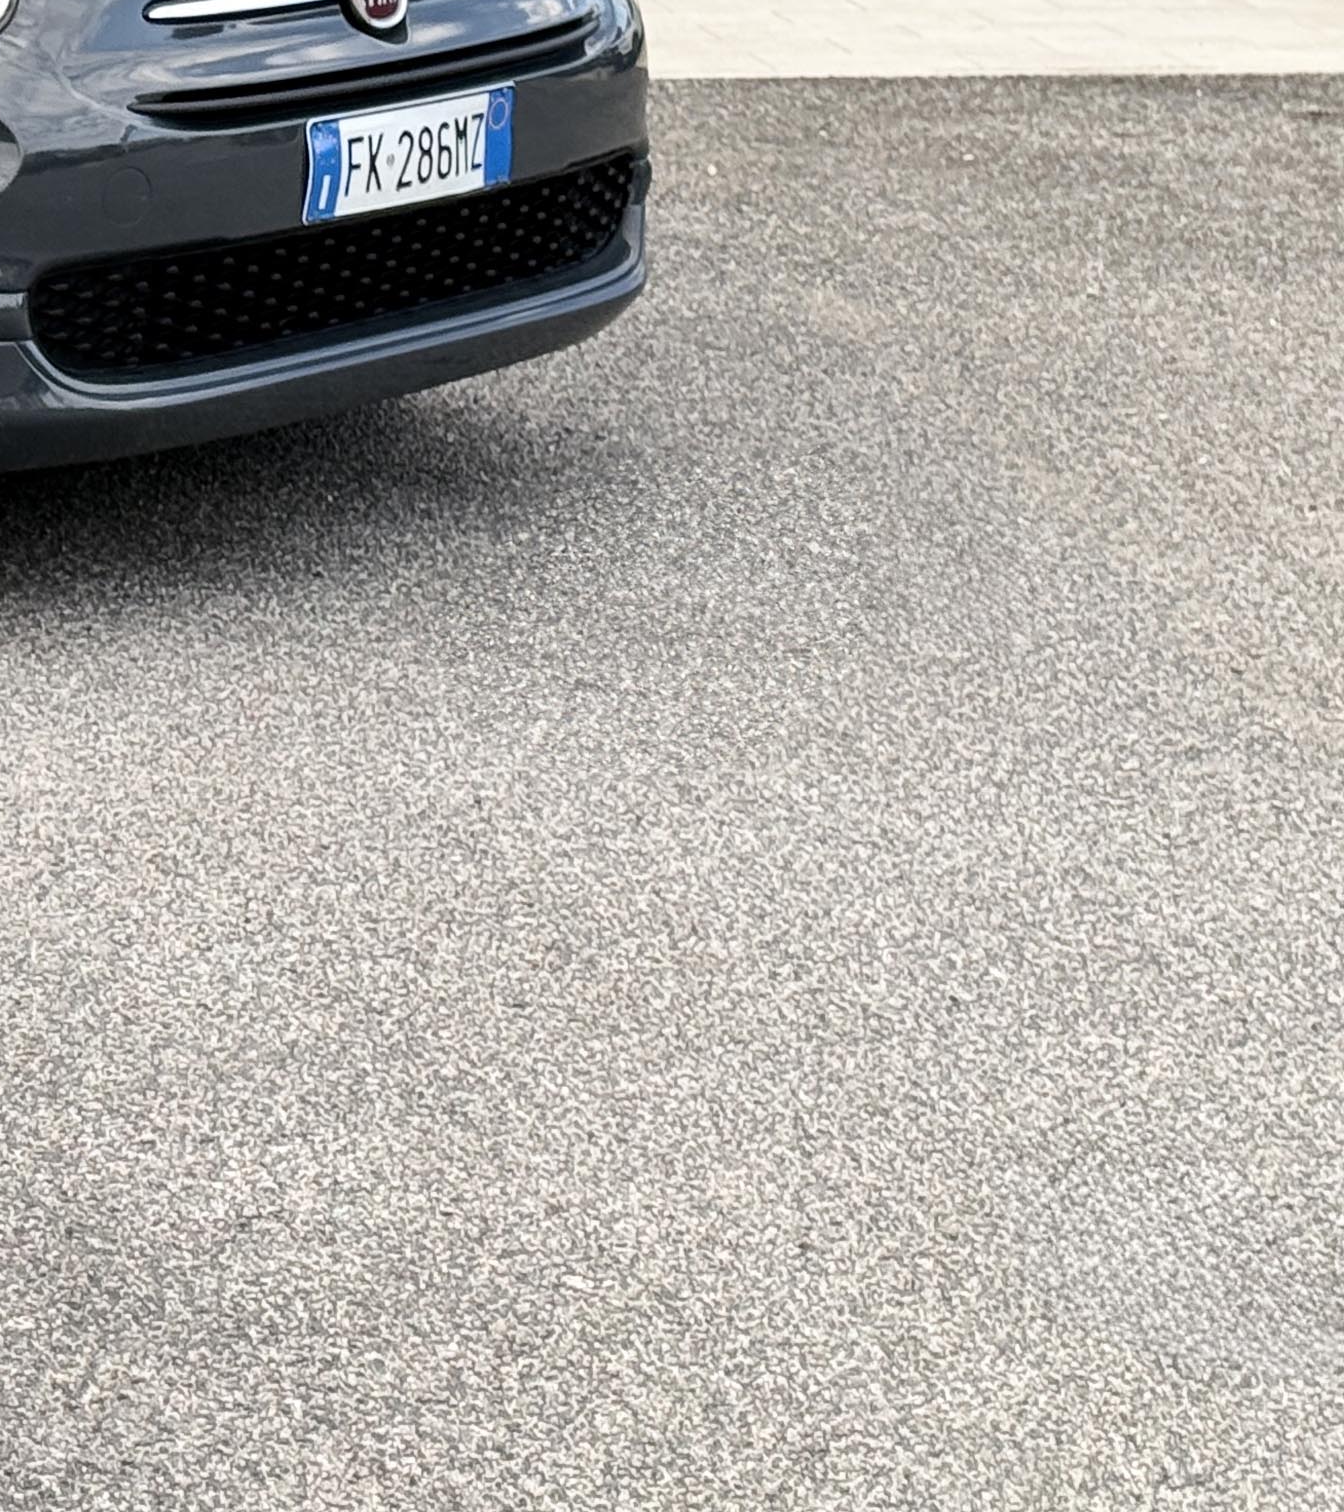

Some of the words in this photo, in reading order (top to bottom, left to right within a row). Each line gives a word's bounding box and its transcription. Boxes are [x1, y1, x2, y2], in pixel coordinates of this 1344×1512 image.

[318, 174, 332, 210] I
[345, 133, 384, 197] FK
[396, 113, 485, 191] 286MZ
